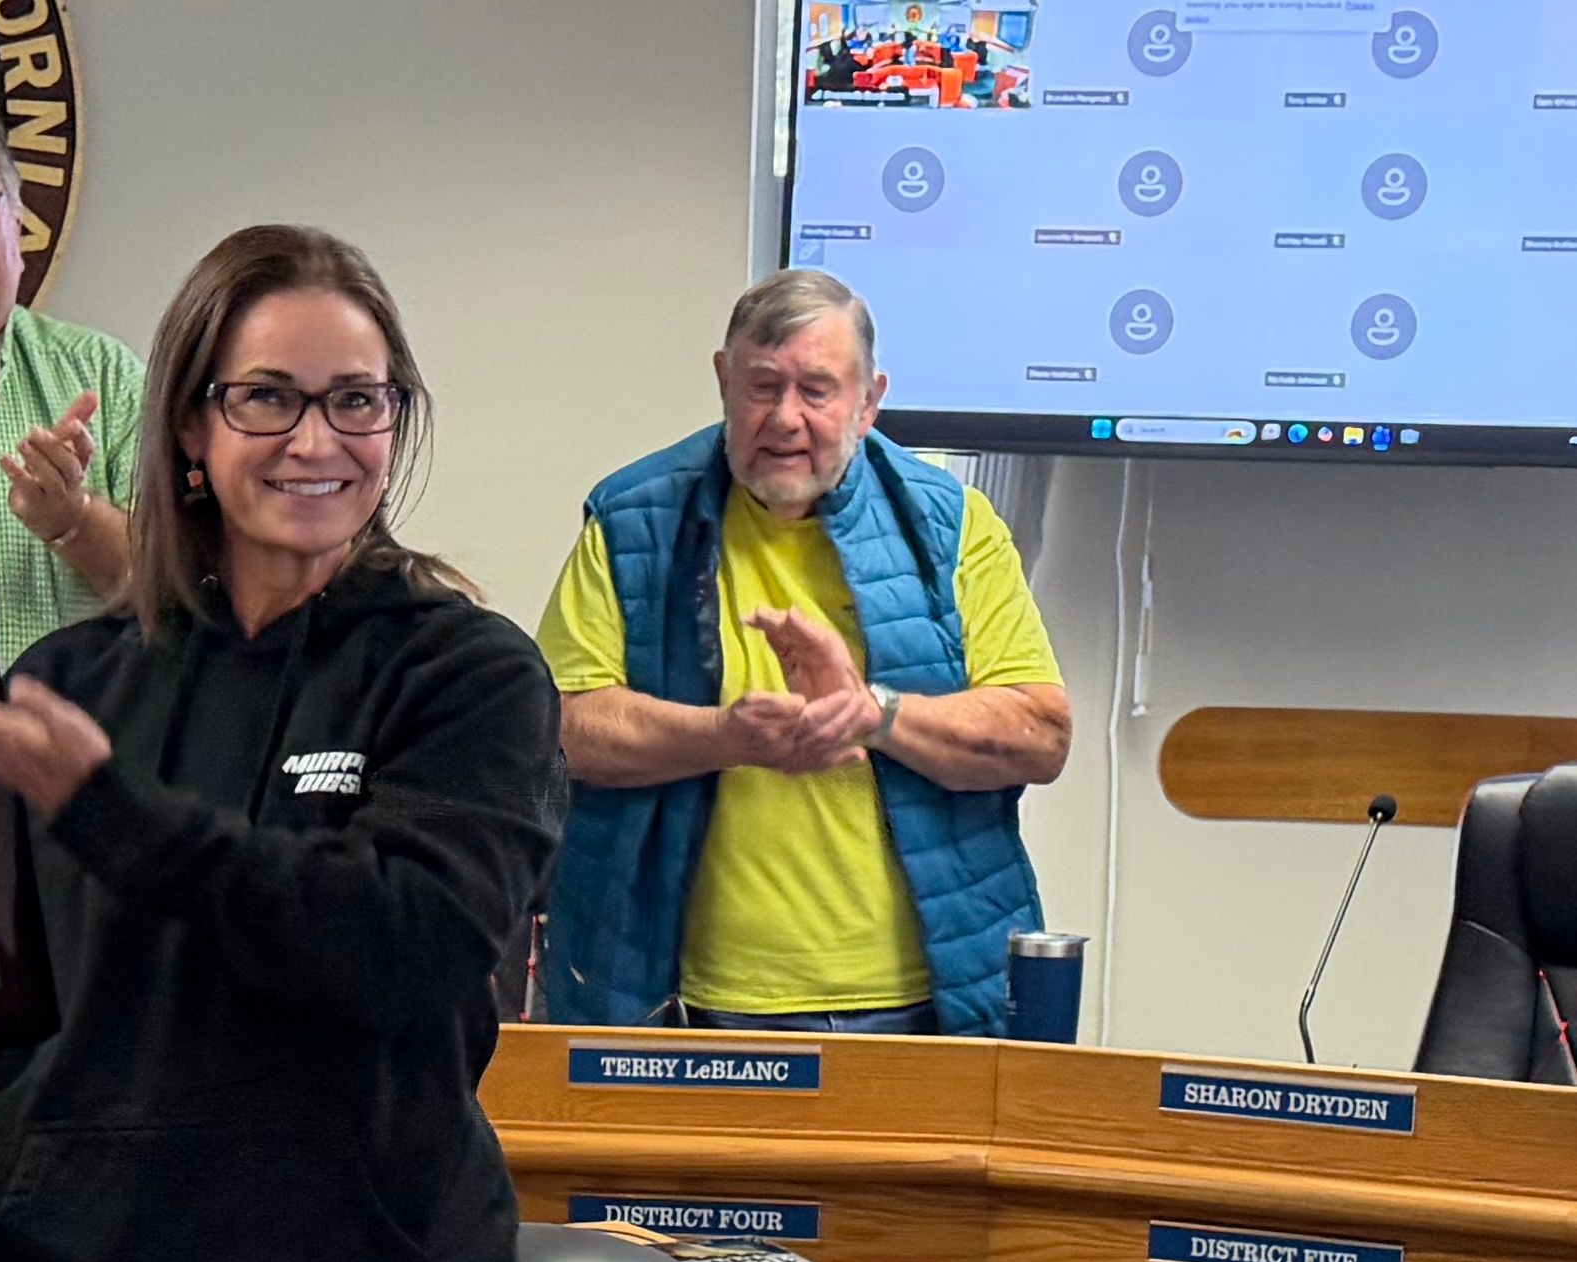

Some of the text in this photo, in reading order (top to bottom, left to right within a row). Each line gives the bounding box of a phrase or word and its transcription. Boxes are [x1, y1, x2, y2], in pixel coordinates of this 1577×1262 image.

[282, 751, 366, 775] MURP
[600, 1056, 789, 1082] TERRY LeBLANC
[1184, 1082, 1388, 1121] SHARON DRYDEN
[605, 1205, 784, 1231] DISTRICT FOUR
